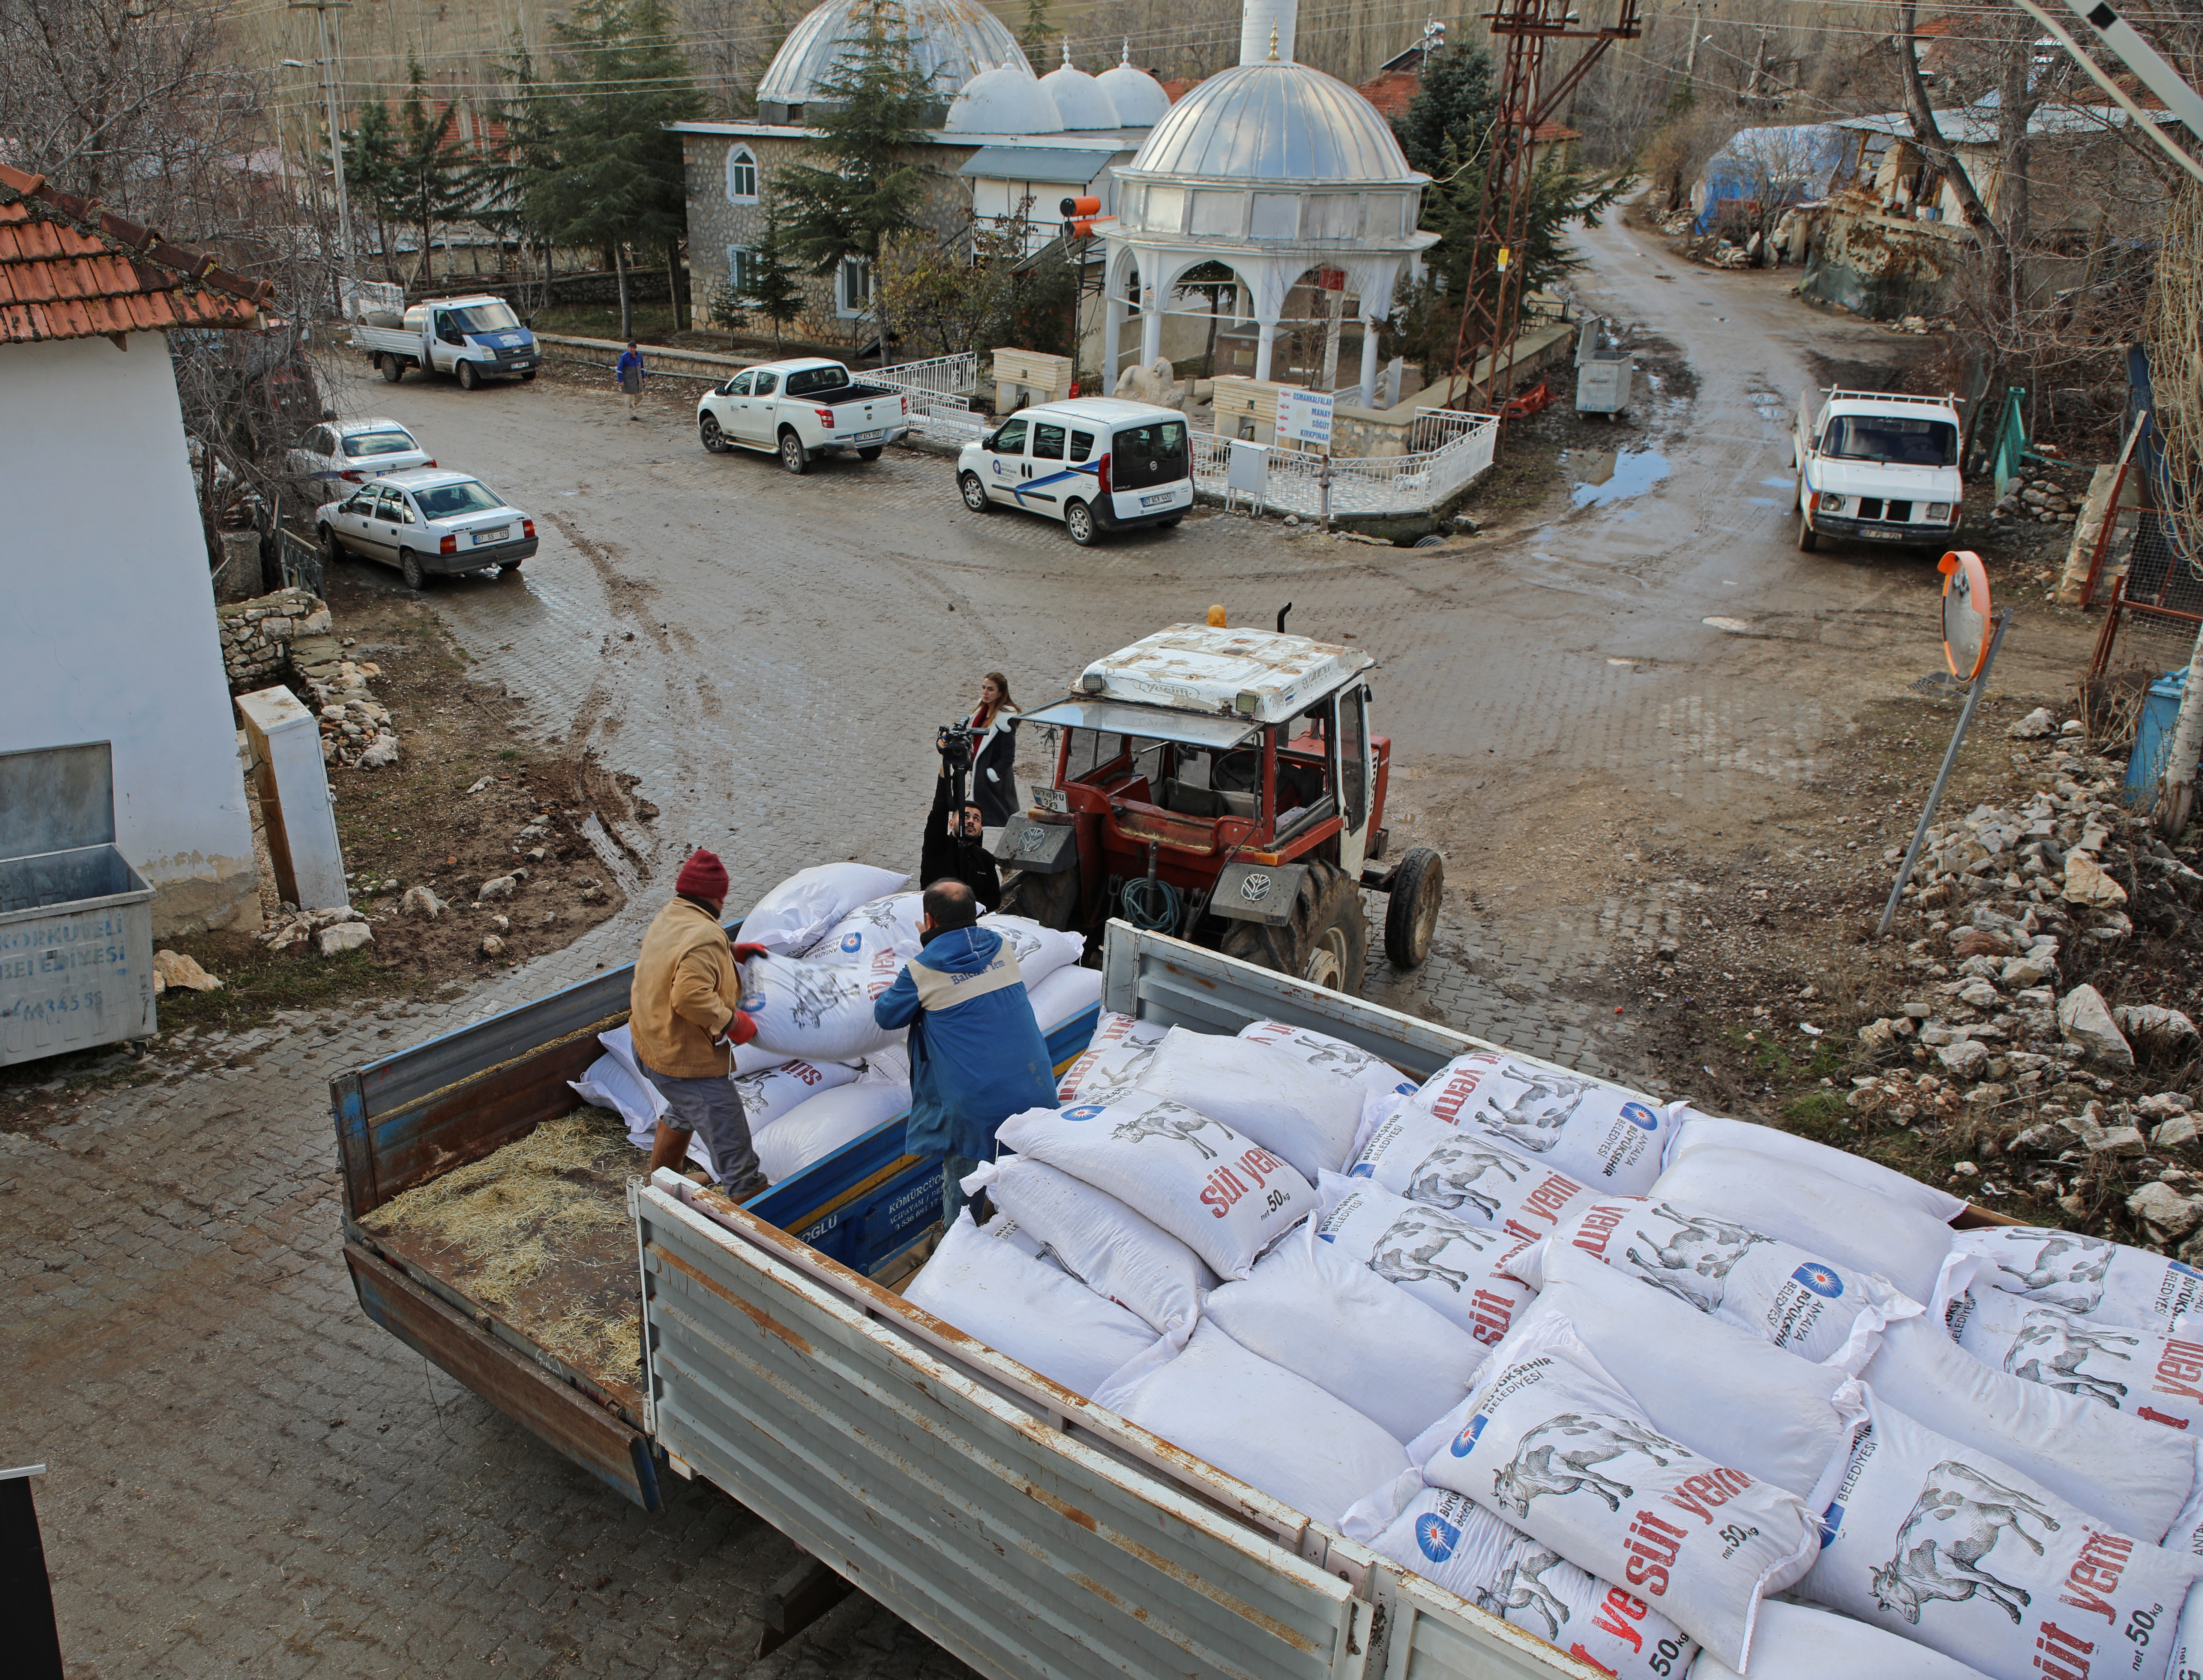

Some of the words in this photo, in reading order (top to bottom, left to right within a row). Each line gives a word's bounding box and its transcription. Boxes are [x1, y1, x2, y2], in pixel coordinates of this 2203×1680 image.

[1293, 392, 1332, 406] OSMANKALFALAR
[1312, 408, 1331, 418] MANAY
[1300, 429, 1329, 441] KIRKPINAR
[1312, 419, 1330, 430] SÖĞÜT
[1308, 663, 1330, 682] FIAT
[1044, 798, 1058, 809] 39
[815, 947, 838, 959] ANTALYA
[990, 960, 1005, 970] Yem
[1100, 1015, 1139, 1041] süt
[1261, 1022, 1300, 1035] üt
[1058, 1048, 1108, 1101] yemi
[1468, 1052, 1505, 1065] üt
[1433, 1068, 1487, 1126] yemi
[1362, 1114, 1403, 1161] BÜYÜKŞEHİR
[1371, 1125, 1405, 1161] BELEDİYESİ
[1596, 1118, 1626, 1159] BELEDİYESİ
[1602, 1124, 1638, 1177] BÜYÜKŞEHİR
[1624, 1132, 1649, 1167] ANTALYA
[889, 1197, 924, 1224] ACIPAYAM
[1200, 1166, 1250, 1219] süt
[1519, 1170, 1583, 1226] yemi
[901, 1214, 914, 1227] 536
[916, 1206, 928, 1218] 691
[930, 1198, 938, 1208] 17
[1261, 1209, 1270, 1221] net
[1321, 1191, 1362, 1232] BÜYÜKŞEHİR
[1331, 1199, 1364, 1232] BELEDİYESİ
[1766, 1281, 1798, 1328] BELEDİYESİ
[2153, 1270, 2179, 1317] BELEDİYESİ
[1793, 1299, 1826, 1342] ANTALYA
[1481, 1358, 1555, 1410] BÜYÜKŞEHİR
[1487, 1370, 1544, 1414] BELEDİYESİ
[1837, 1440, 1879, 1503] BELEDİYESİ
[1623, 1510, 1689, 1596] süt
[1721, 1546, 1735, 1560] net
[2058, 1524, 2134, 1626] yemi
[1591, 1587, 1648, 1654] ye
[2033, 1621, 2095, 1680] üt
[2131, 1649, 2144, 1672] net
